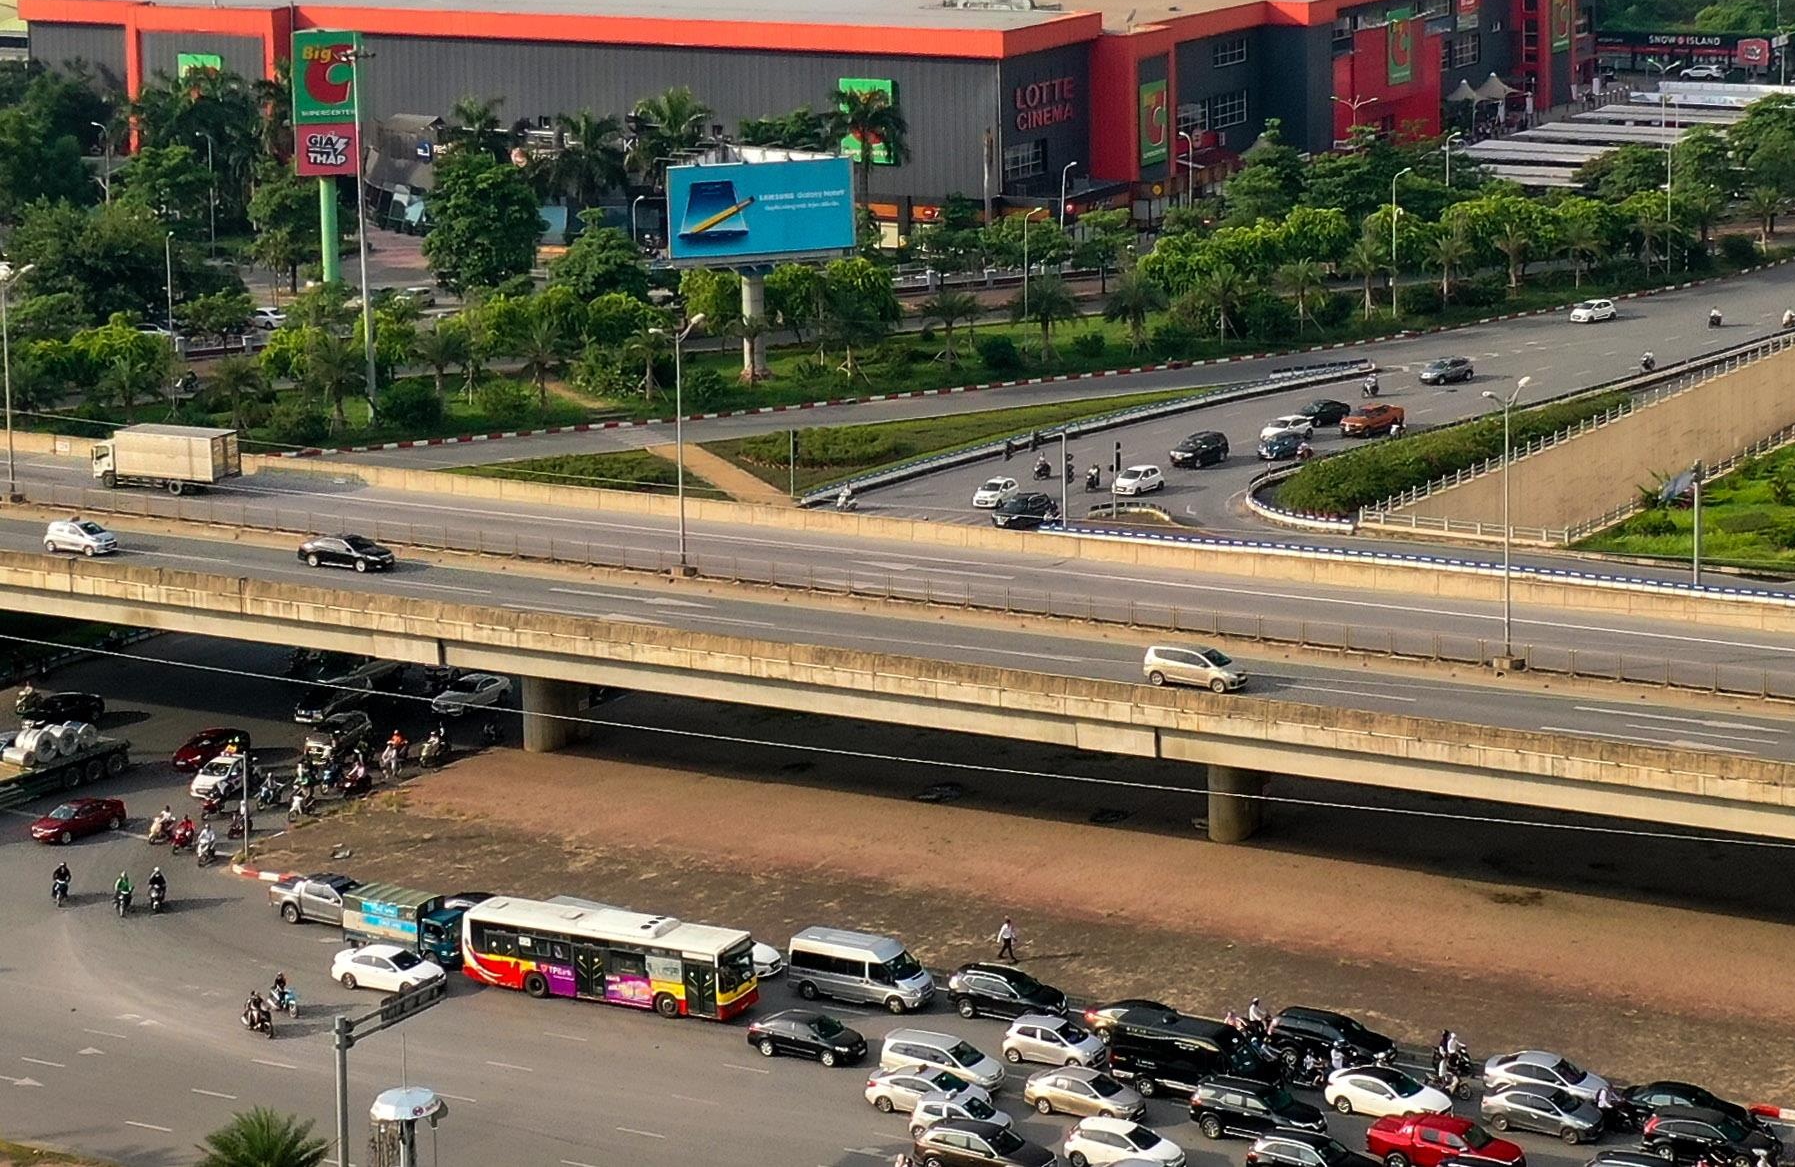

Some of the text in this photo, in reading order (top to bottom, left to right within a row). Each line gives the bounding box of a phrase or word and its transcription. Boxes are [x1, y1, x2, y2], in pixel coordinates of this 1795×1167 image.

[1648, 36, 1720, 45] SNOW ISLAND
[303, 46, 332, 63] Big
[1015, 77, 1073, 109] LOTTE
[1016, 102, 1074, 131] CINEMA
